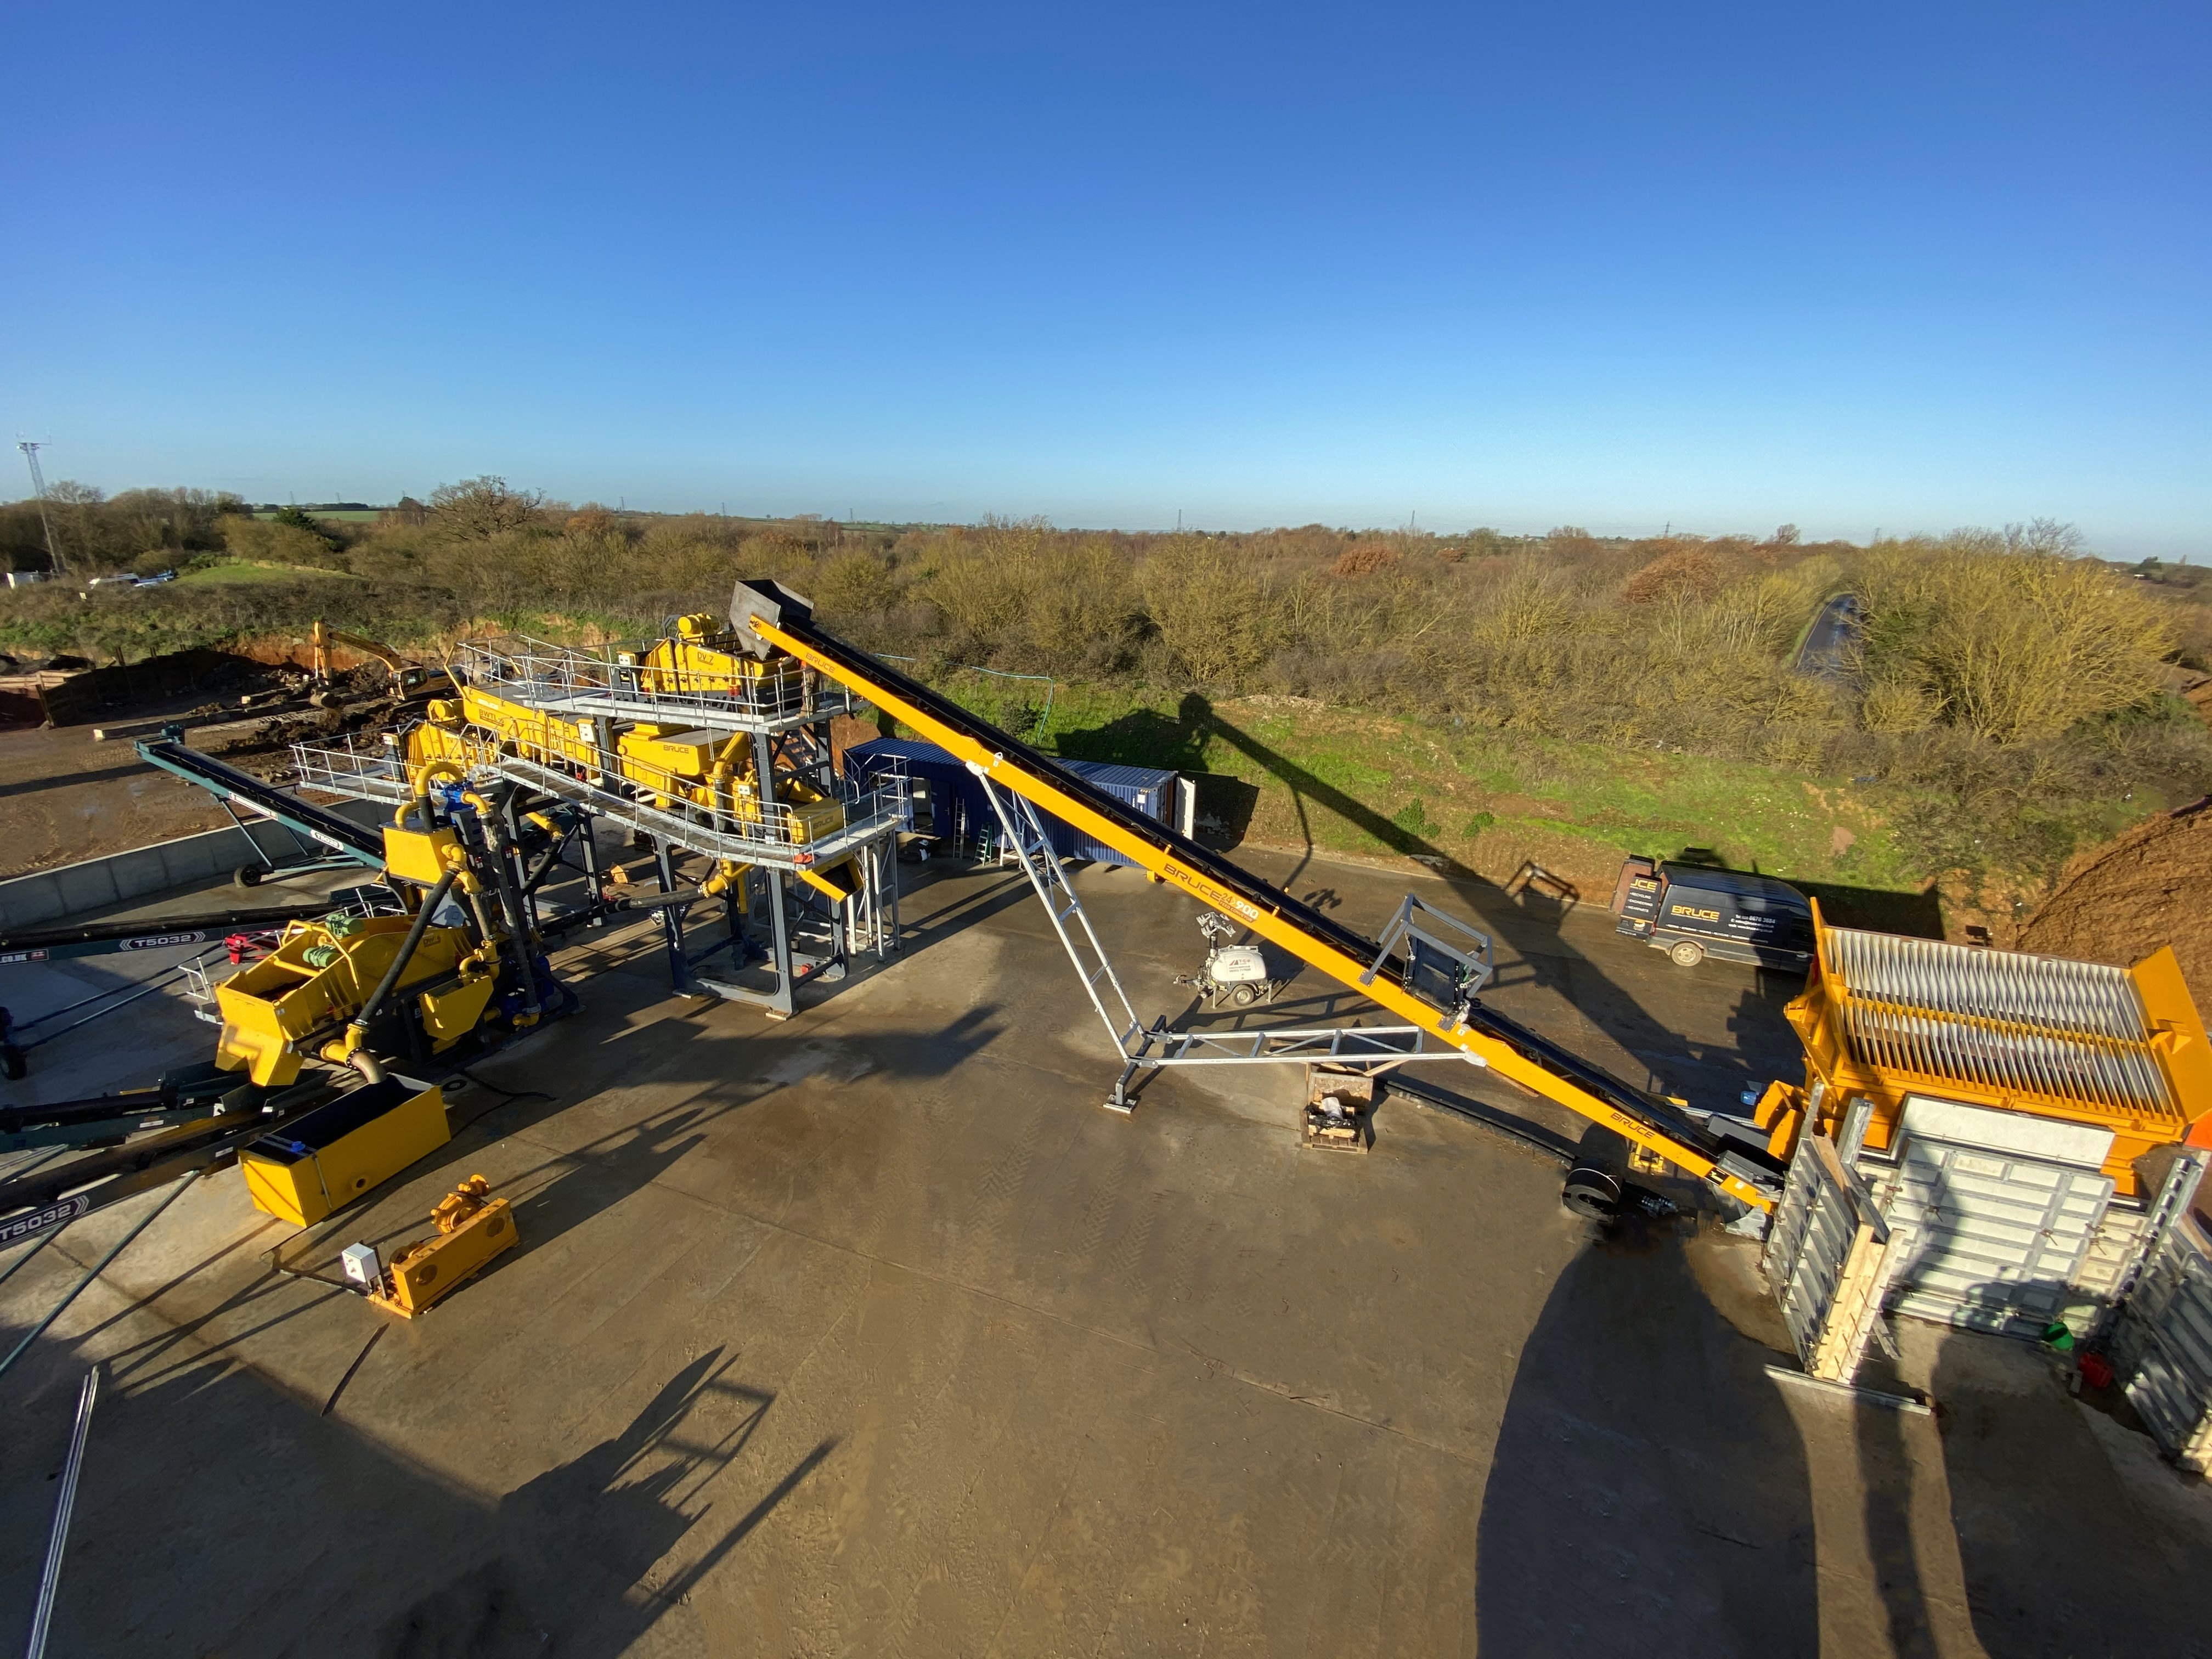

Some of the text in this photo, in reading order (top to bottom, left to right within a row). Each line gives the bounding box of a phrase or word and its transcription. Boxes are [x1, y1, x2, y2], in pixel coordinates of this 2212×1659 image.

[806, 652, 836, 673] BRUCE
[663, 745, 689, 754] BRUCE
[1164, 863, 1222, 901] BRUCE
[1235, 900, 1259, 919] 900
[1231, 907, 1253, 922] CONVEYOR
[1672, 905, 1720, 920] BRUCE
[135, 935, 192, 948] T5032
[1610, 1112, 1656, 1139] BRUCE
[0, 1204, 71, 1240] T5032
